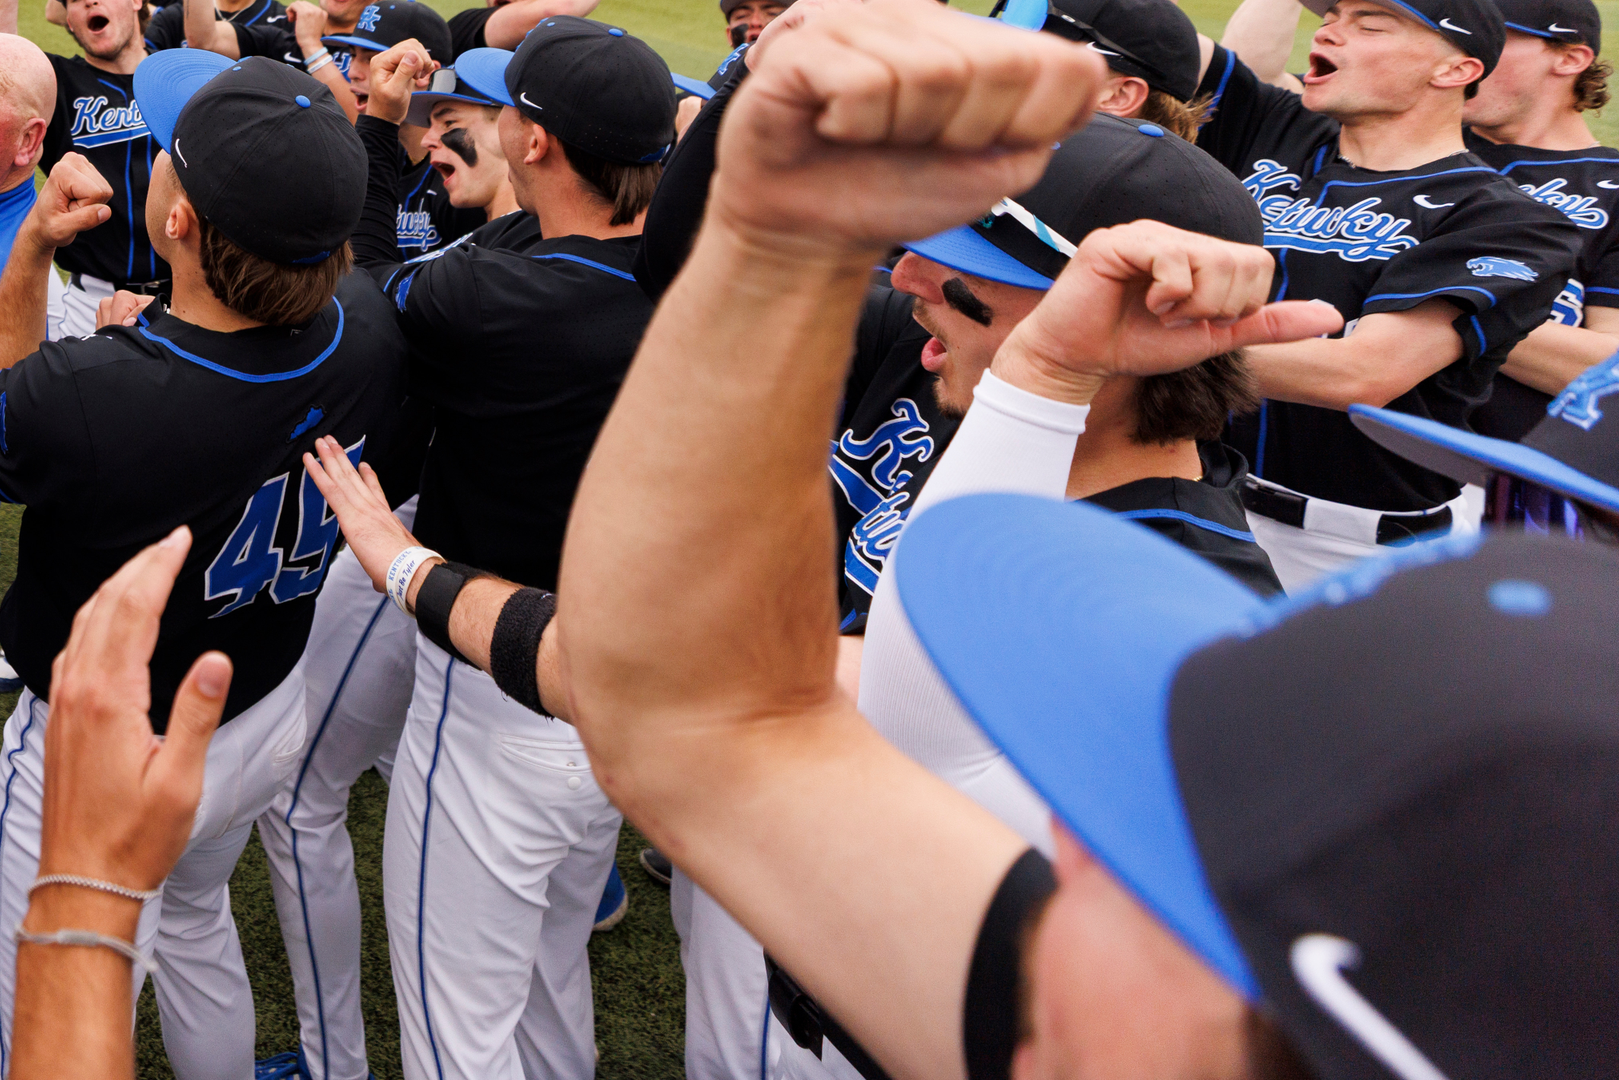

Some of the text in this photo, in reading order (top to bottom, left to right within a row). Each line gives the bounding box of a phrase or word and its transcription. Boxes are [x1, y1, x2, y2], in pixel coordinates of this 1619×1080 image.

[71, 96, 147, 136] Kent
[204, 434, 367, 619] 45
[388, 550, 412, 581] KENTUCKY
[402, 560, 416, 577] Tyler
